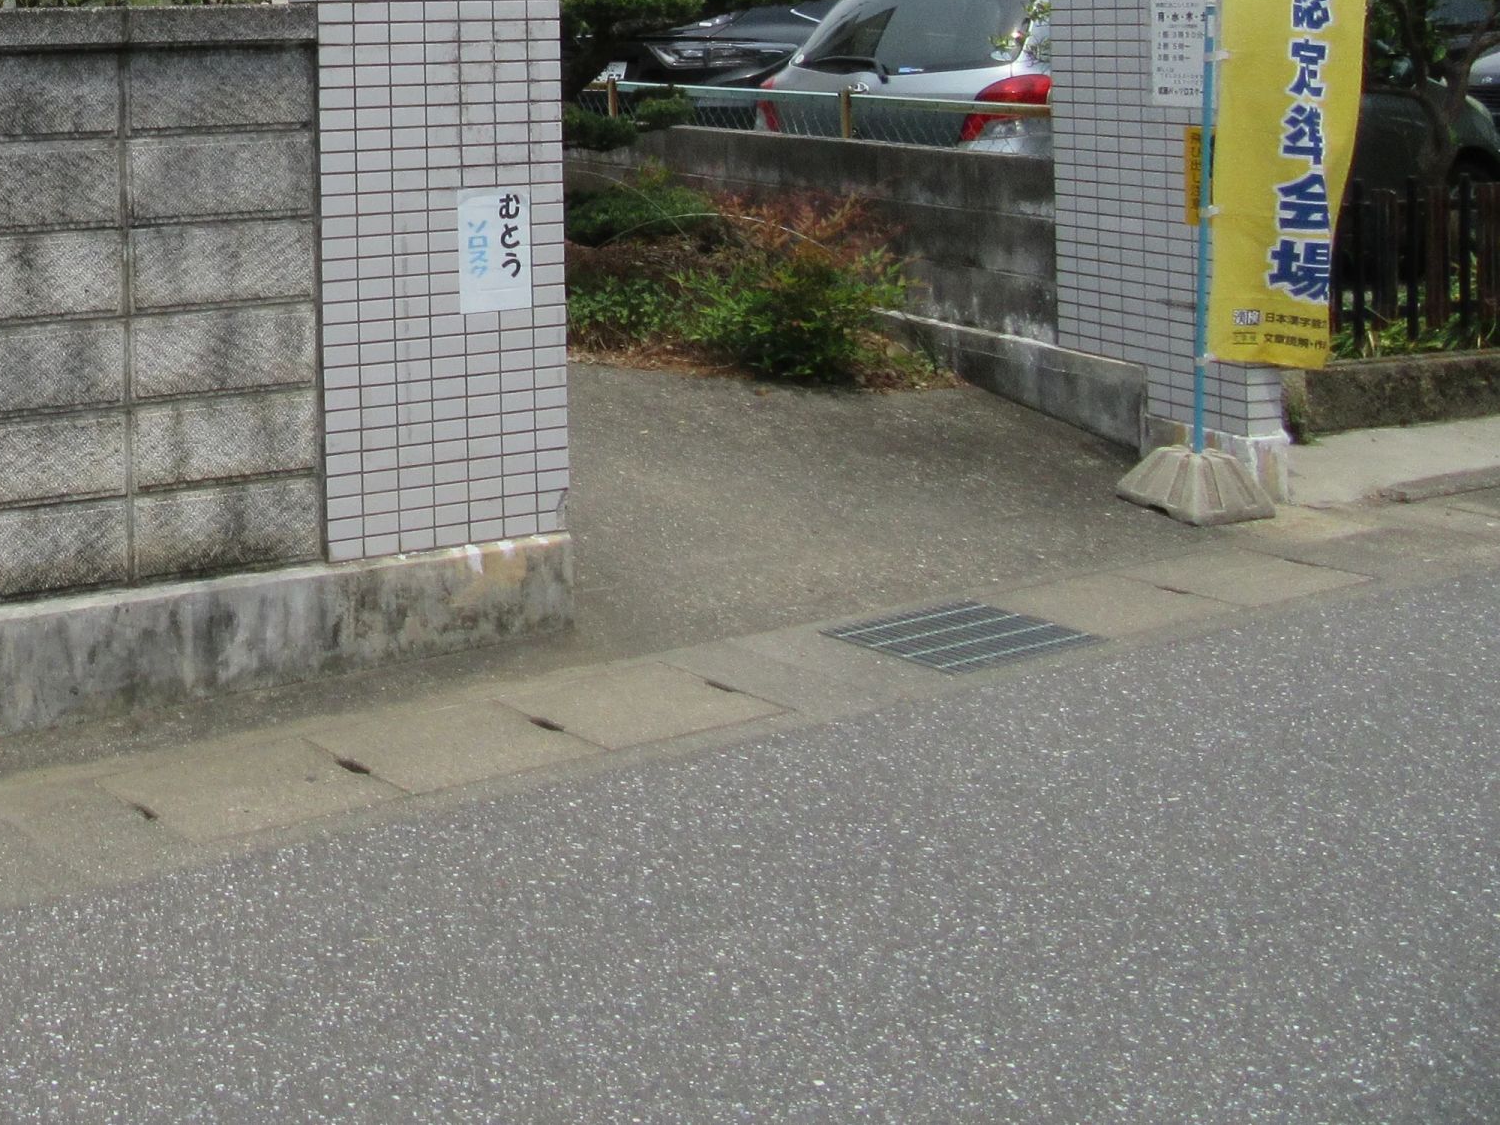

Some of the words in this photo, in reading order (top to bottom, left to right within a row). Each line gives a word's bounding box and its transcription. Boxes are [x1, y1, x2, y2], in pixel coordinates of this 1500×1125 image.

[467, 220, 488, 277] ソロスク
[499, 193, 521, 278] むとう
[1265, 312, 1327, 329] 日本漢字能
